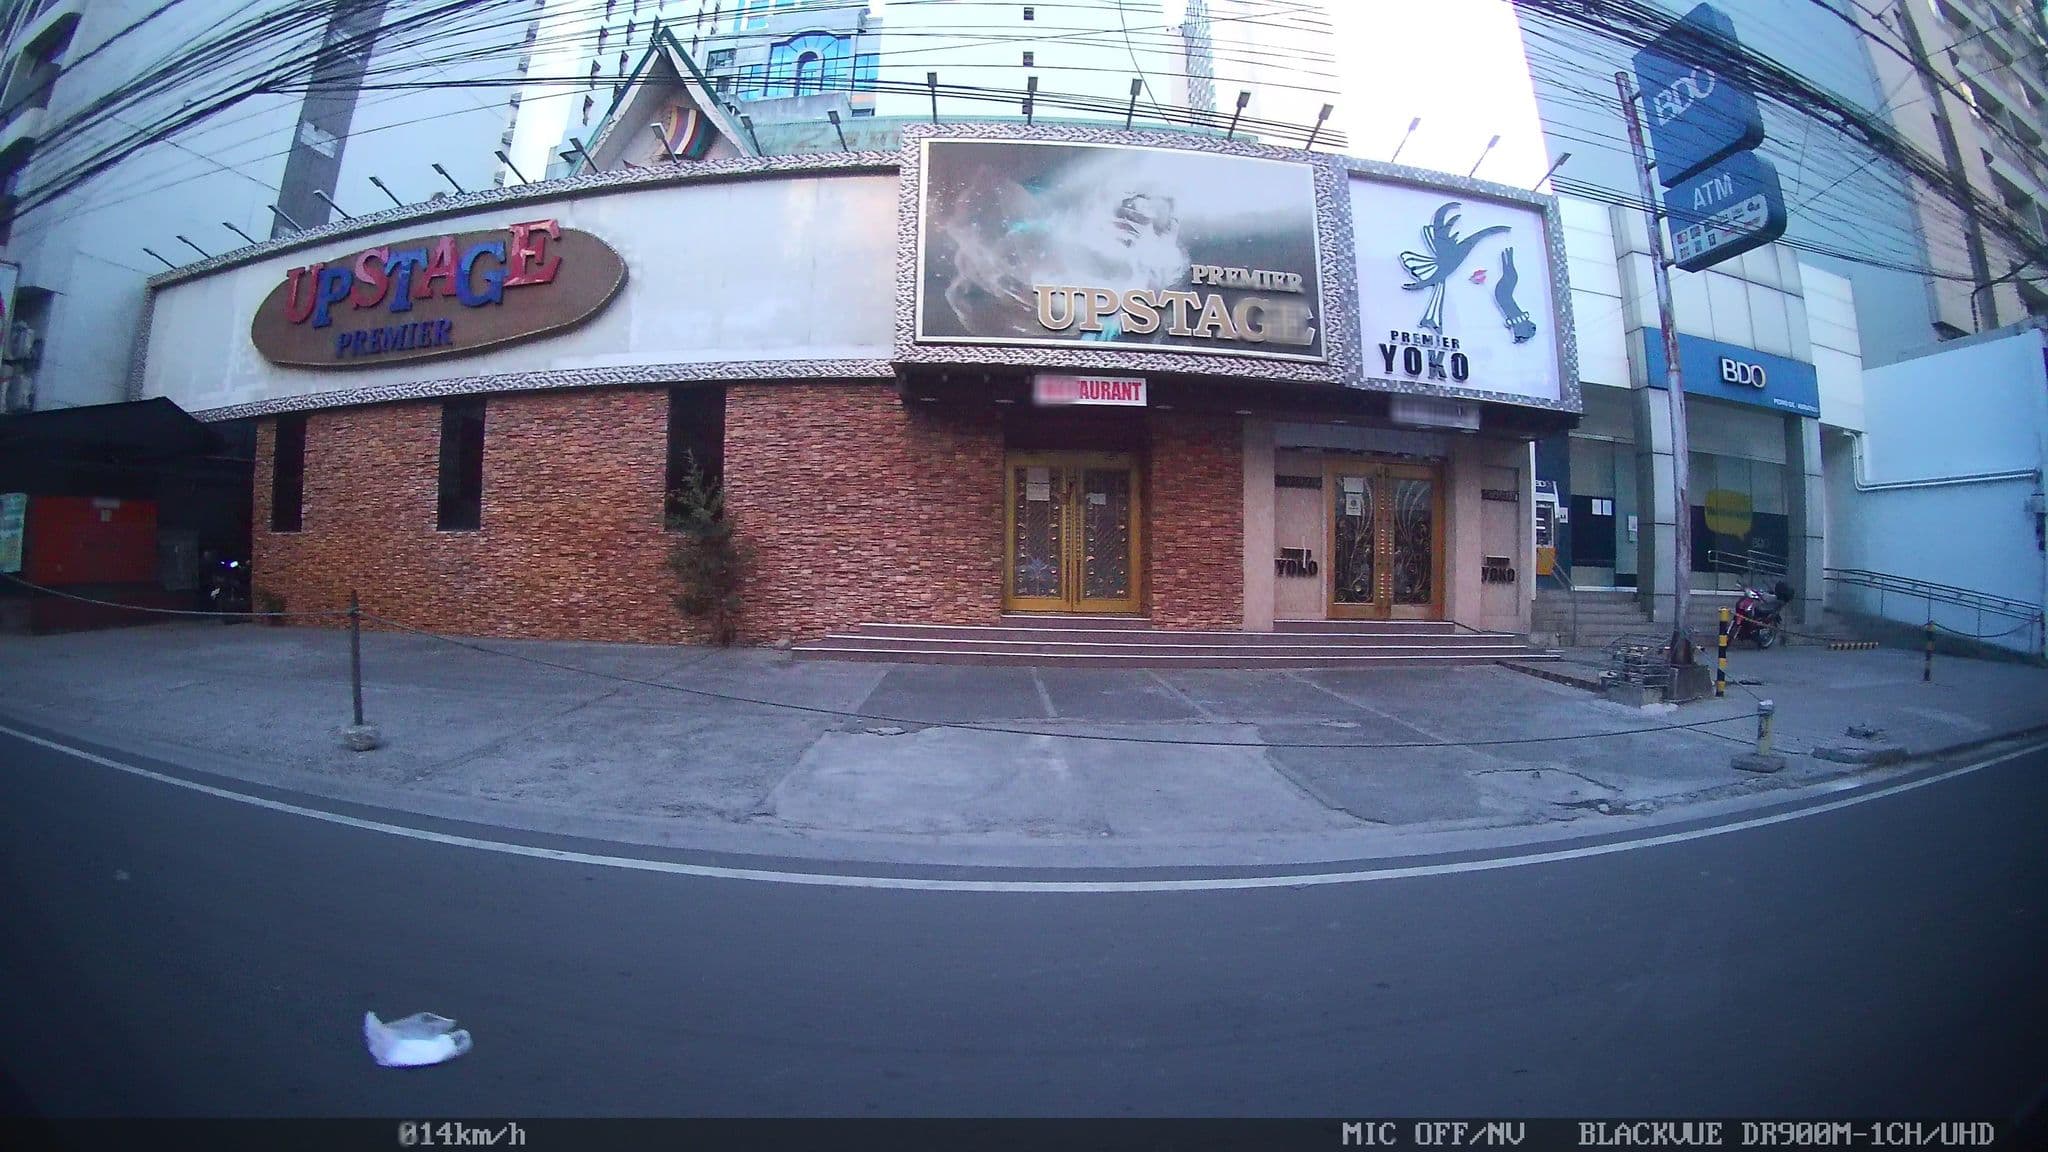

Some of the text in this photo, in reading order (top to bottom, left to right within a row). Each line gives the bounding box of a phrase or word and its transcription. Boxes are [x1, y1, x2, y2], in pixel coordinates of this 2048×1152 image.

[1653, 66, 1716, 126] BDO
[1693, 173, 1734, 210] ATM
[286, 219, 562, 329] UPSTAGE
[1190, 264, 1304, 293] PREMIER
[336, 319, 454, 358] PREMIER
[1389, 330, 1460, 349] PREMIER
[1378, 343, 1470, 383] YOKO
[1721, 358, 1767, 388] BDO
[1042, 379, 1142, 401] AURANT
